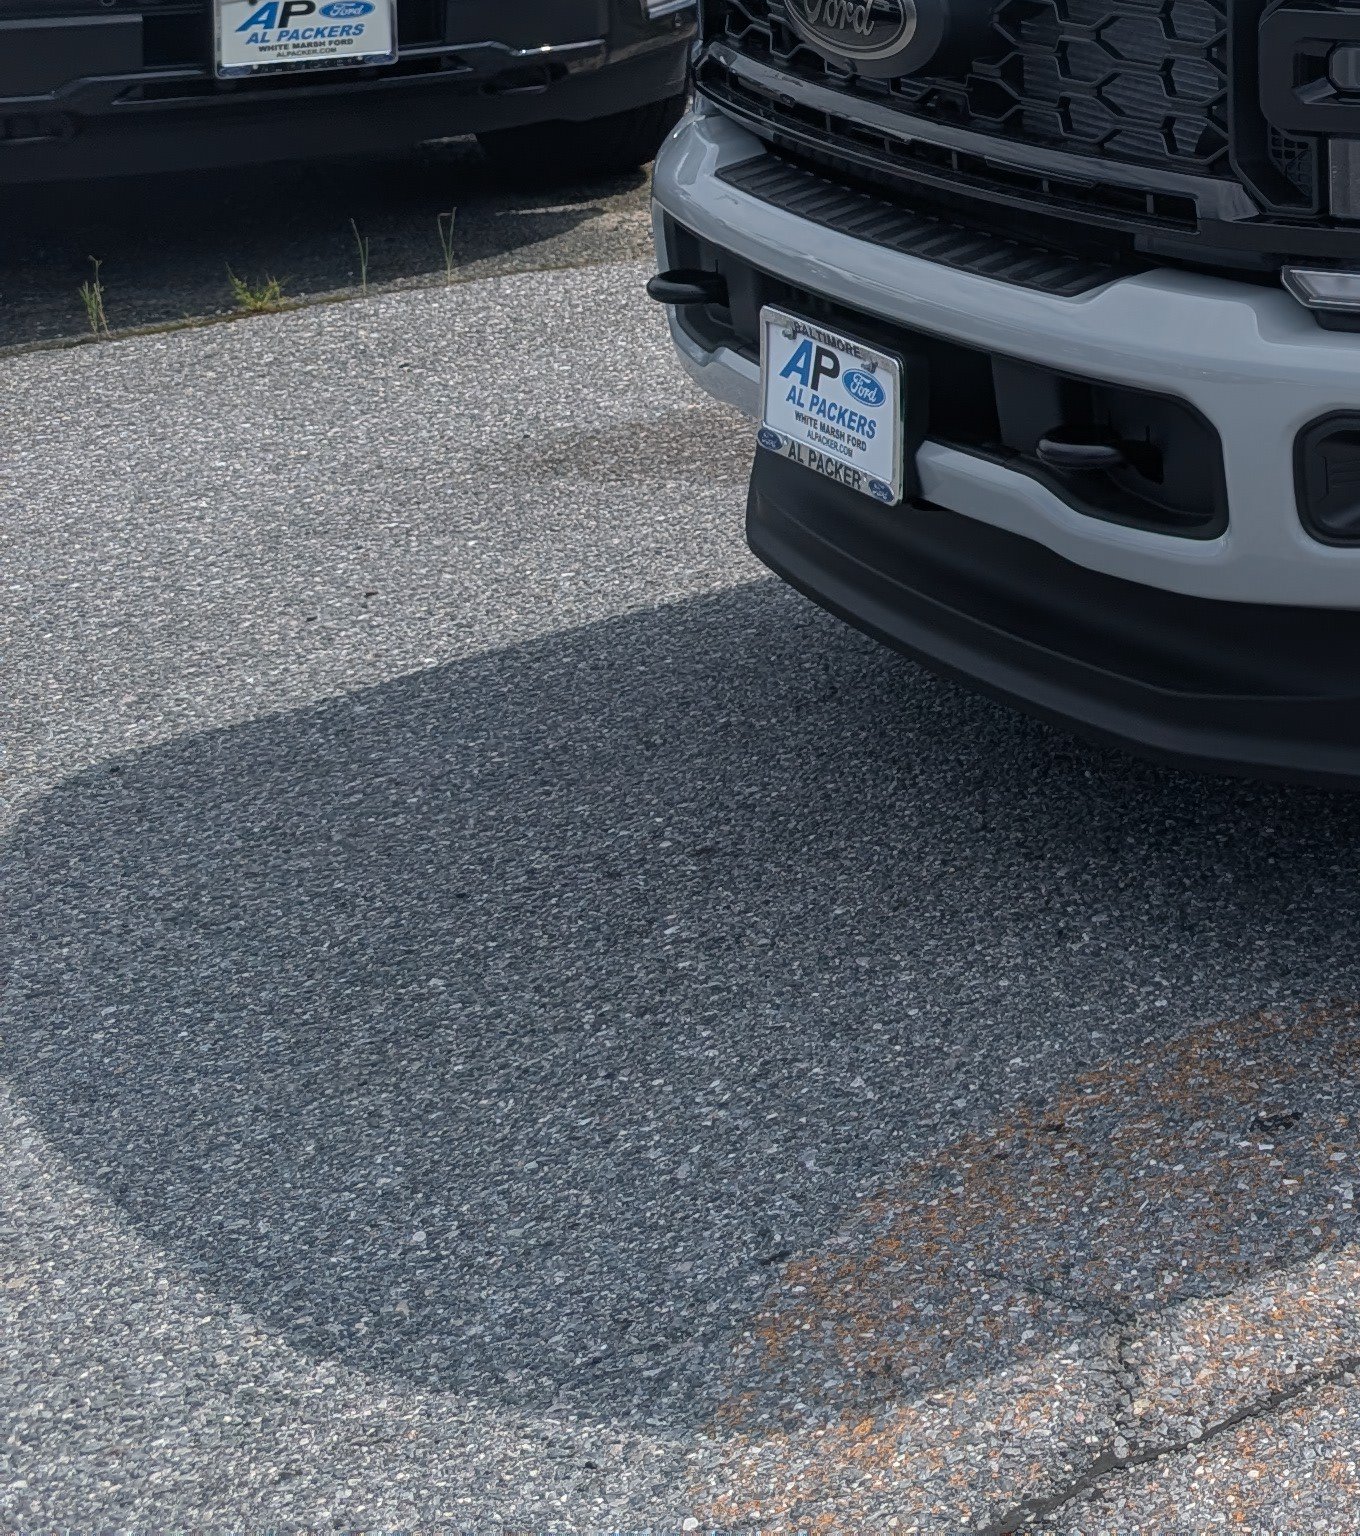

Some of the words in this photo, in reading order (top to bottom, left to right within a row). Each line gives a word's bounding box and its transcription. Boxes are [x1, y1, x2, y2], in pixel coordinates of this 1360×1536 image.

[235, 0, 317, 33] AP
[329, 2, 365, 16] Ford
[246, 30, 271, 46] AL
[277, 23, 365, 43] PACKERS
[258, 43, 291, 53] WHITE
[292, 40, 327, 50] MARSH
[328, 38, 354, 47] FORD
[792, 320, 864, 360] BALTIMORE
[778, 338, 841, 393] AP
[849, 371, 879, 403] Ford
[785, 384, 805, 409] AL
[807, 394, 878, 441] PACKERS
[794, 409, 819, 431] WHITE
[819, 422, 846, 442] MARSH
[846, 435, 867, 453] FORD
[806, 428, 854, 459] ALPACKER.COM
[787, 442, 804, 463] AL
[807, 449, 862, 491] PACKER
